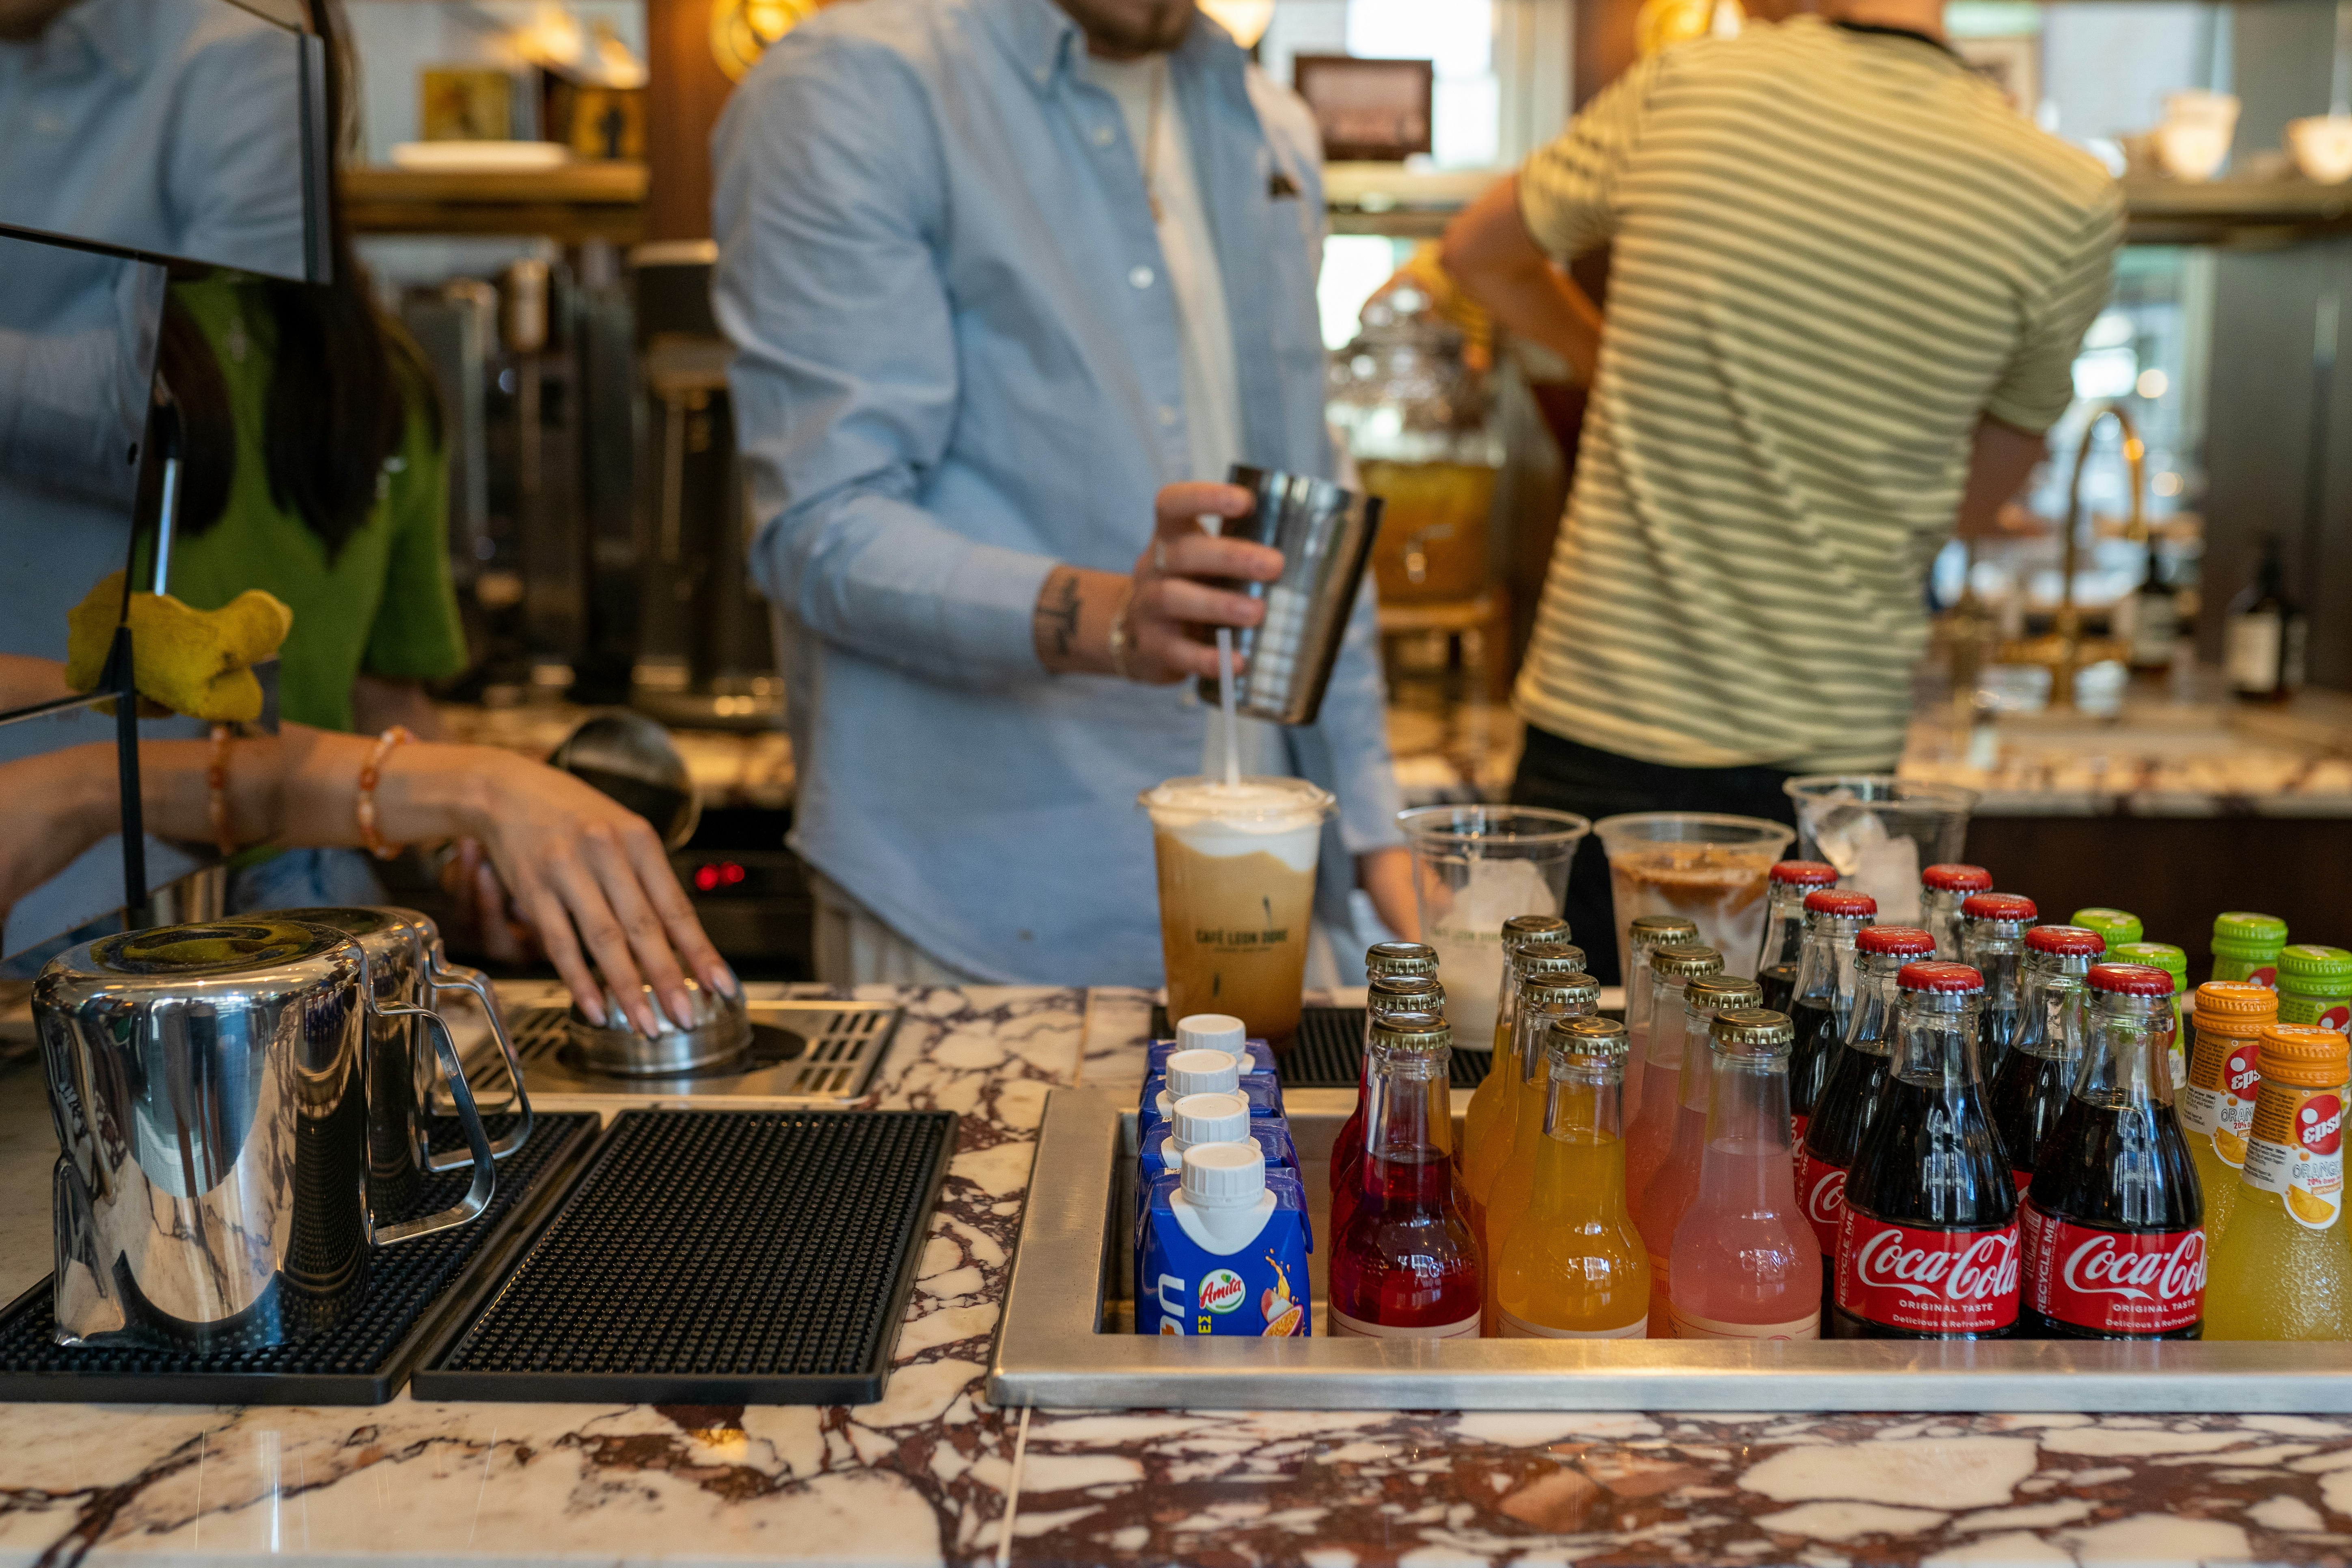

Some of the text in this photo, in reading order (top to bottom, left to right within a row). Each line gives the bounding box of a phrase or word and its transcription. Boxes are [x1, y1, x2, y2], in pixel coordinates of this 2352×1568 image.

[1839, 1238, 1850, 1307] RECYCLE
[1845, 1210, 1854, 1236] ME
[1857, 1229, 2018, 1300] Coca-Cola
[2037, 1219, 2056, 1315] RECYCLE ME
[1199, 1277, 1241, 1309] Amita
[1899, 1298, 1994, 1313] ORIGINAL TASTE
[2112, 1298, 2196, 1313] ORIGINAL TASTE
[1892, 1314, 1938, 1327] Delicious
[1949, 1319, 1996, 1328] Refreshing
[2105, 1318, 2152, 1328] Delicious
